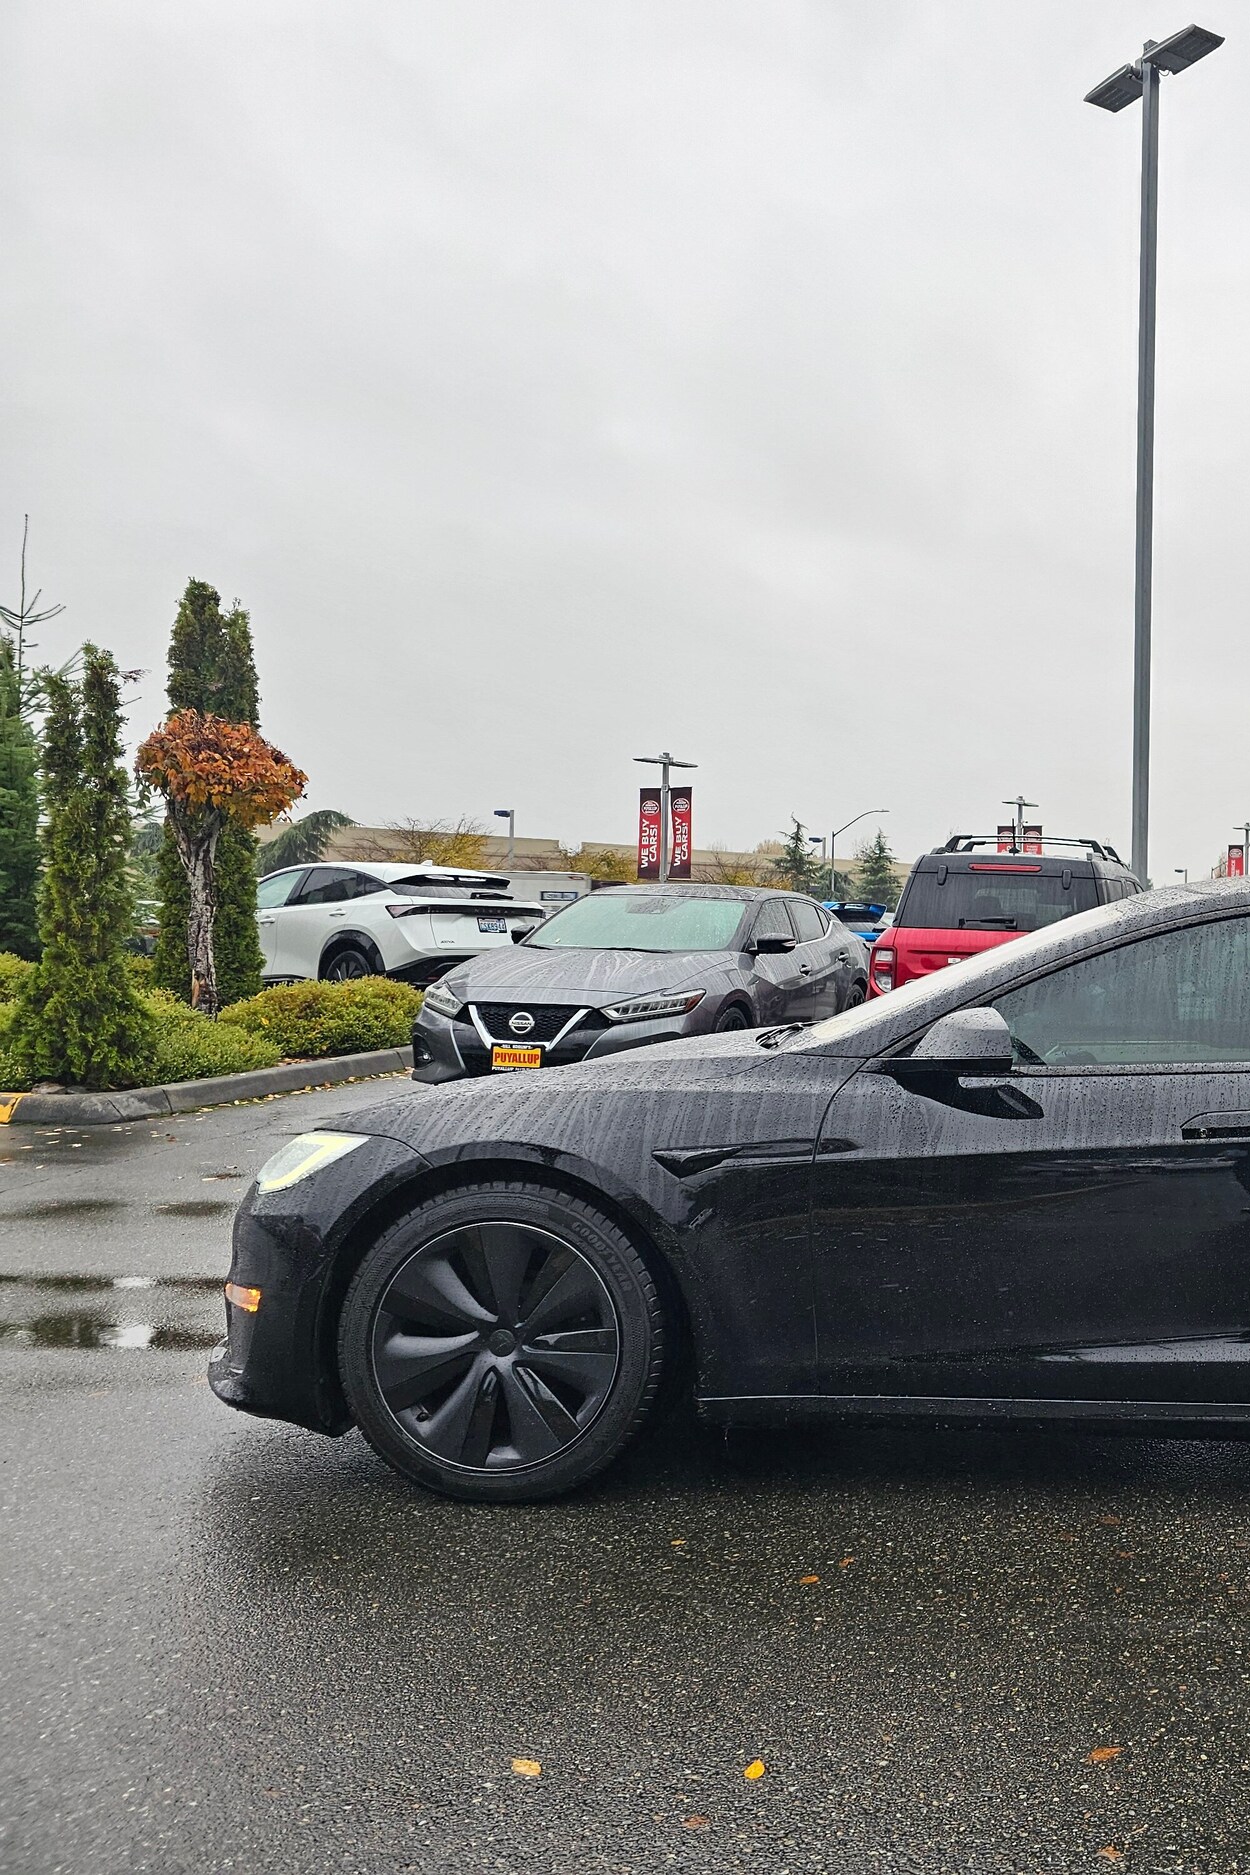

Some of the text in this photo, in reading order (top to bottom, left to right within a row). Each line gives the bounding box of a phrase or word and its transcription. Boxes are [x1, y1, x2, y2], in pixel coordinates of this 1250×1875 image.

[641, 818, 650, 868] WE BUY
[649, 824, 658, 862] CARS!
[674, 817, 682, 843] BUY
[681, 822, 689, 860] CARS!
[673, 847, 681, 867] WE
[494, 1052, 540, 1065] PUYALLUP
[571, 1221, 634, 1292] GOODYEAR
